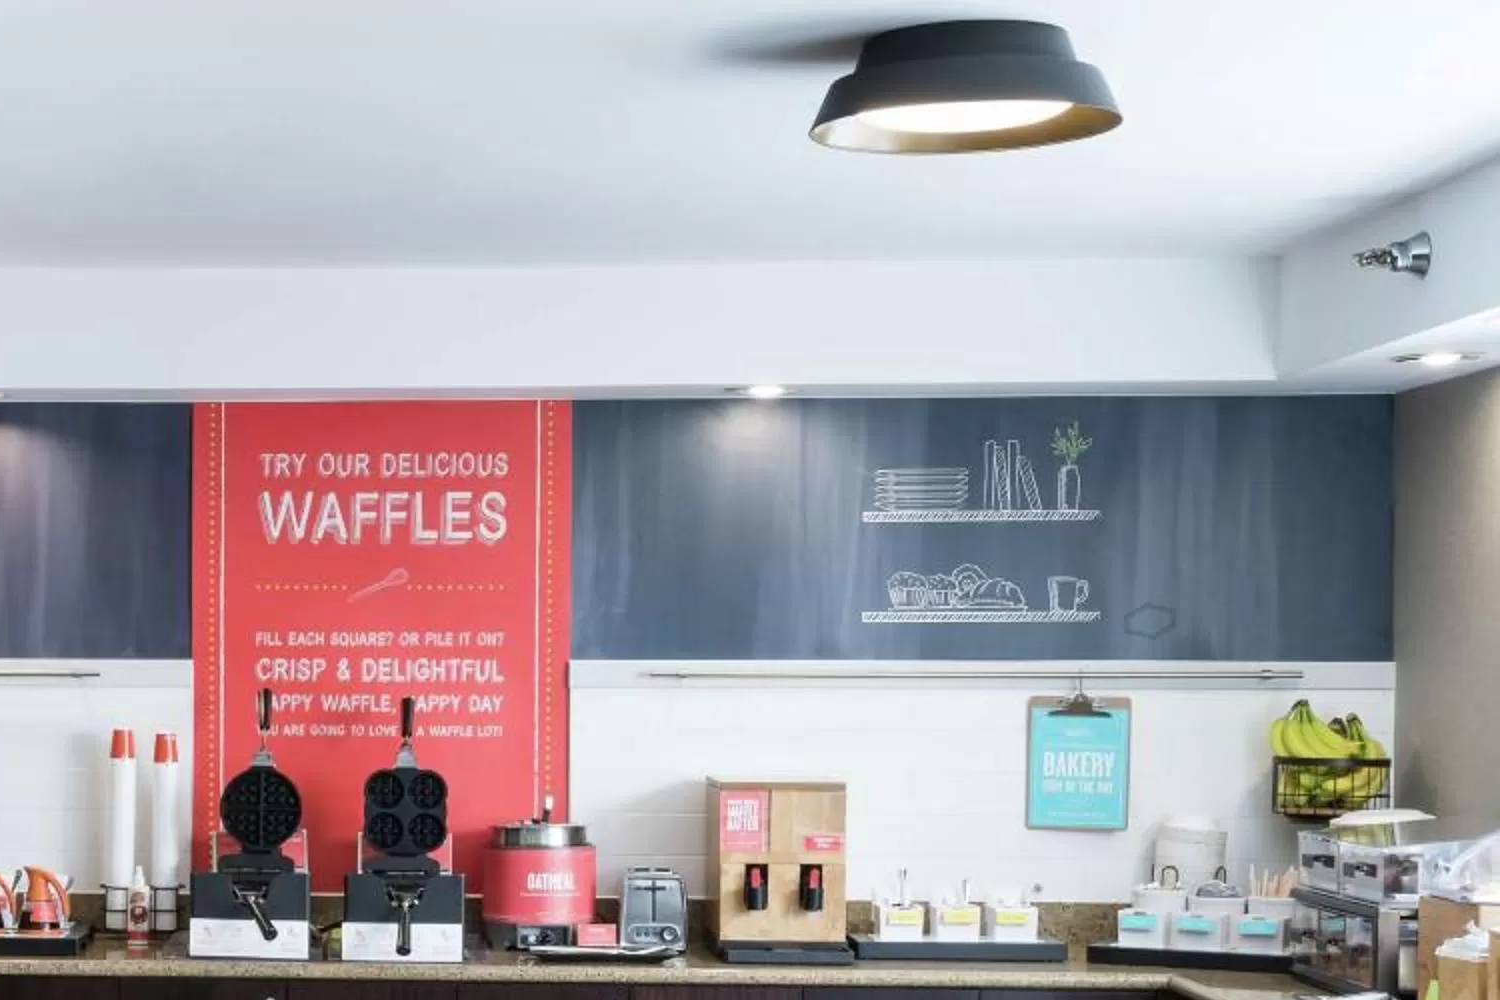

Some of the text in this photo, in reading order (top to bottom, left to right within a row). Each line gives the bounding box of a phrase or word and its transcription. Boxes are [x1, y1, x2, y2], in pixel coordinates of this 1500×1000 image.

[259, 451, 510, 478] TRY OUR DELICIOUS
[258, 489, 508, 545] WAFFLES
[255, 631, 283, 646] FILL
[288, 631, 325, 647] EACH
[330, 631, 393, 647] SQUARE?
[399, 631, 420, 646] OR
[425, 631, 454, 646] PILE
[459, 631, 471, 646] IT
[255, 657, 505, 682] CRISP & DELIGHTFUL
[321, 693, 397, 715] WAFFLE,
[406, 694, 462, 713] APPY
[468, 694, 504, 713] DAY
[283, 724, 306, 736] ARE
[310, 724, 345, 736] GOING
[351, 724, 365, 736] TO
[369, 724, 399, 736] LOVE
[416, 725, 425, 736] A
[429, 725, 474, 737] WAFFLE
[1043, 751, 1115, 777] BAKERY
[527, 872, 576, 892] OATMEAL
